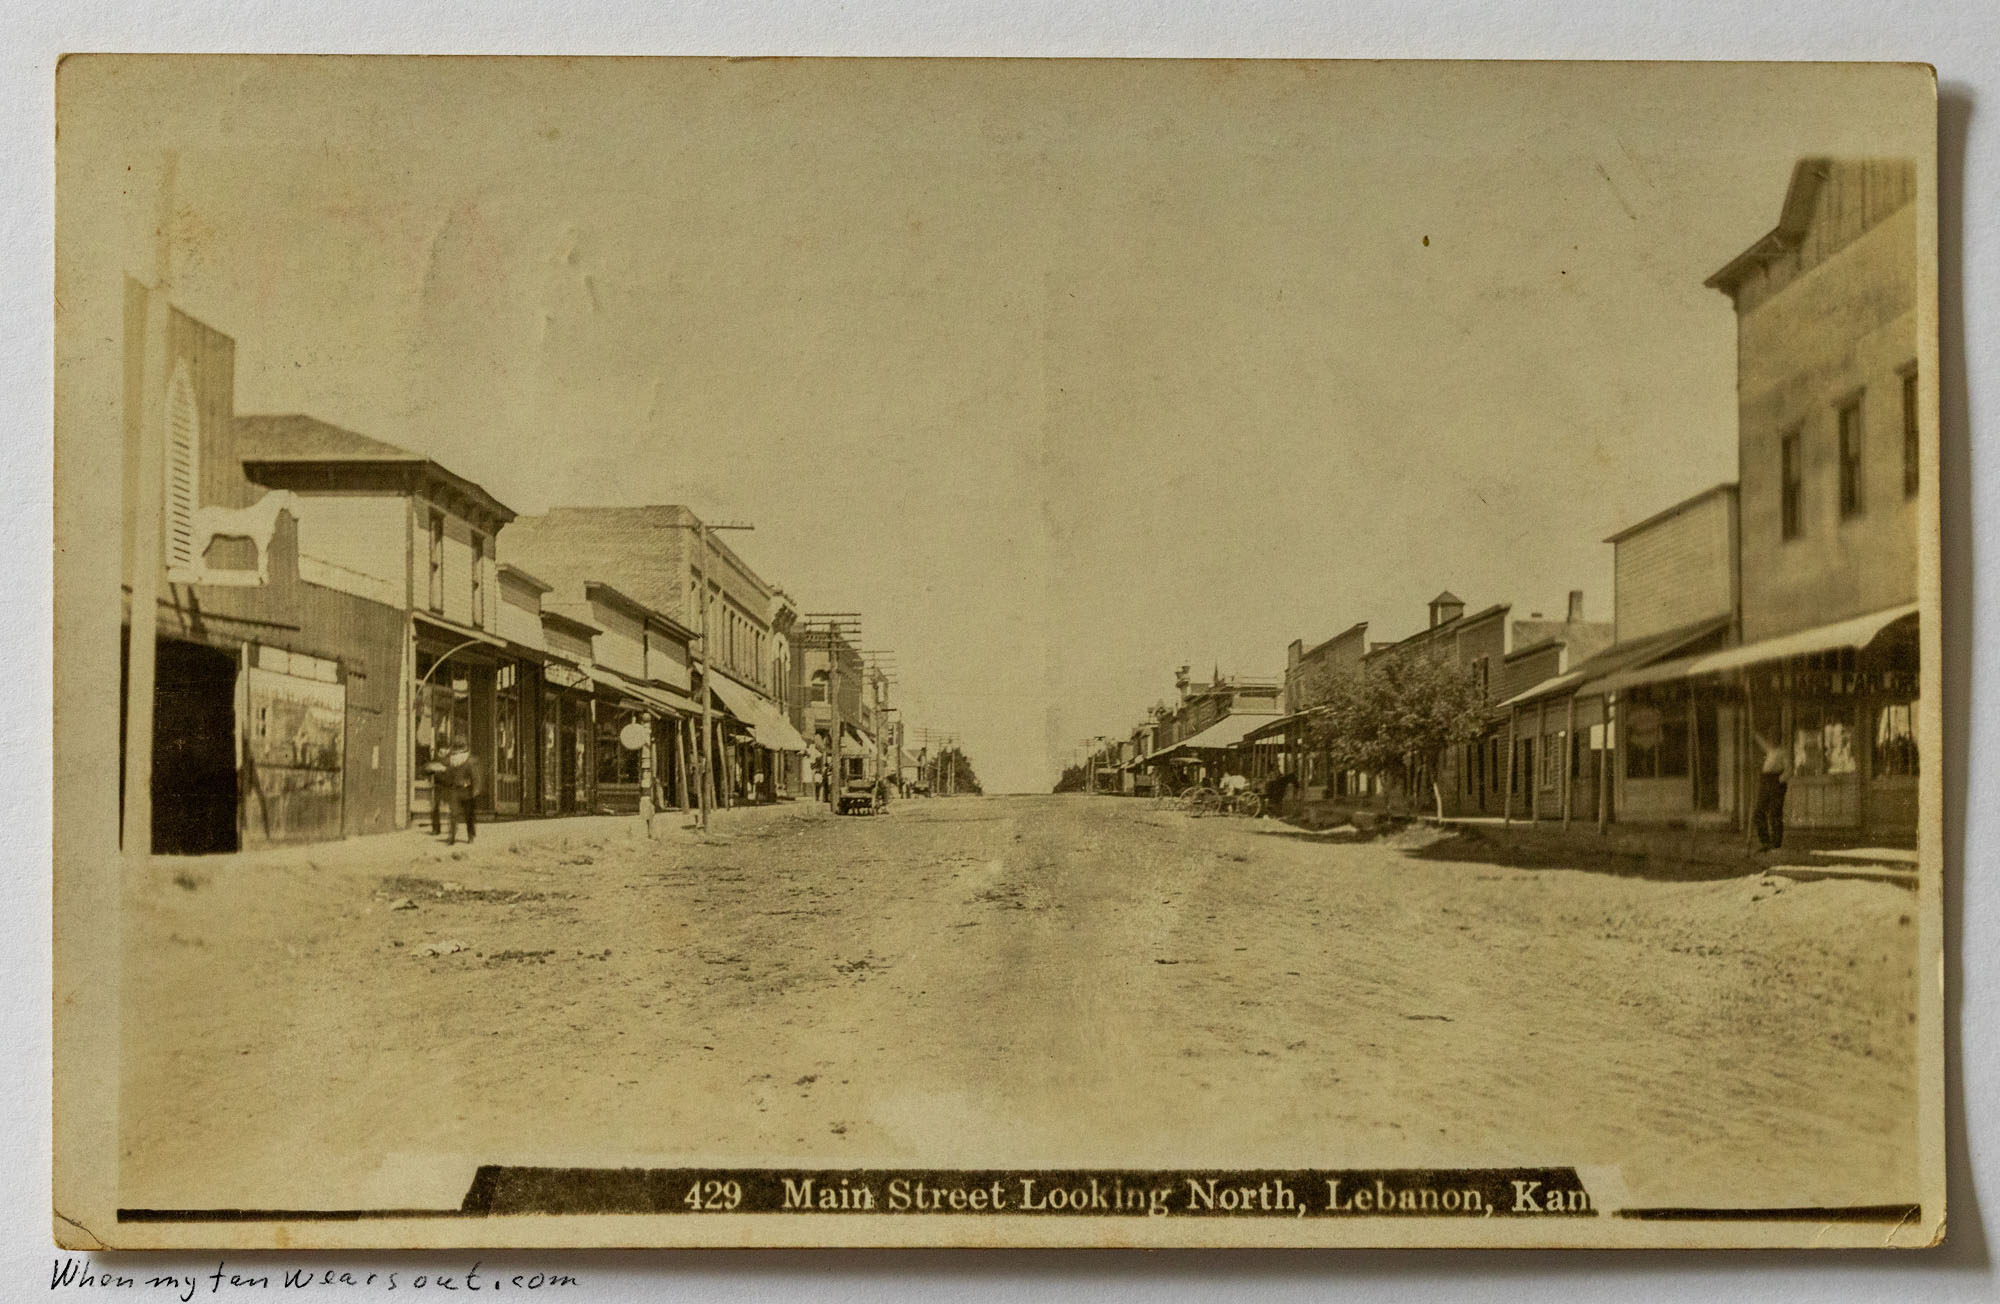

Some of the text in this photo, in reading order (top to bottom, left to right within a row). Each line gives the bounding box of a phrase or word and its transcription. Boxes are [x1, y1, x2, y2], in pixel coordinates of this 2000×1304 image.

[684, 1178, 1588, 1217] 429 Main Street Looking North, Lebanon, Kan
